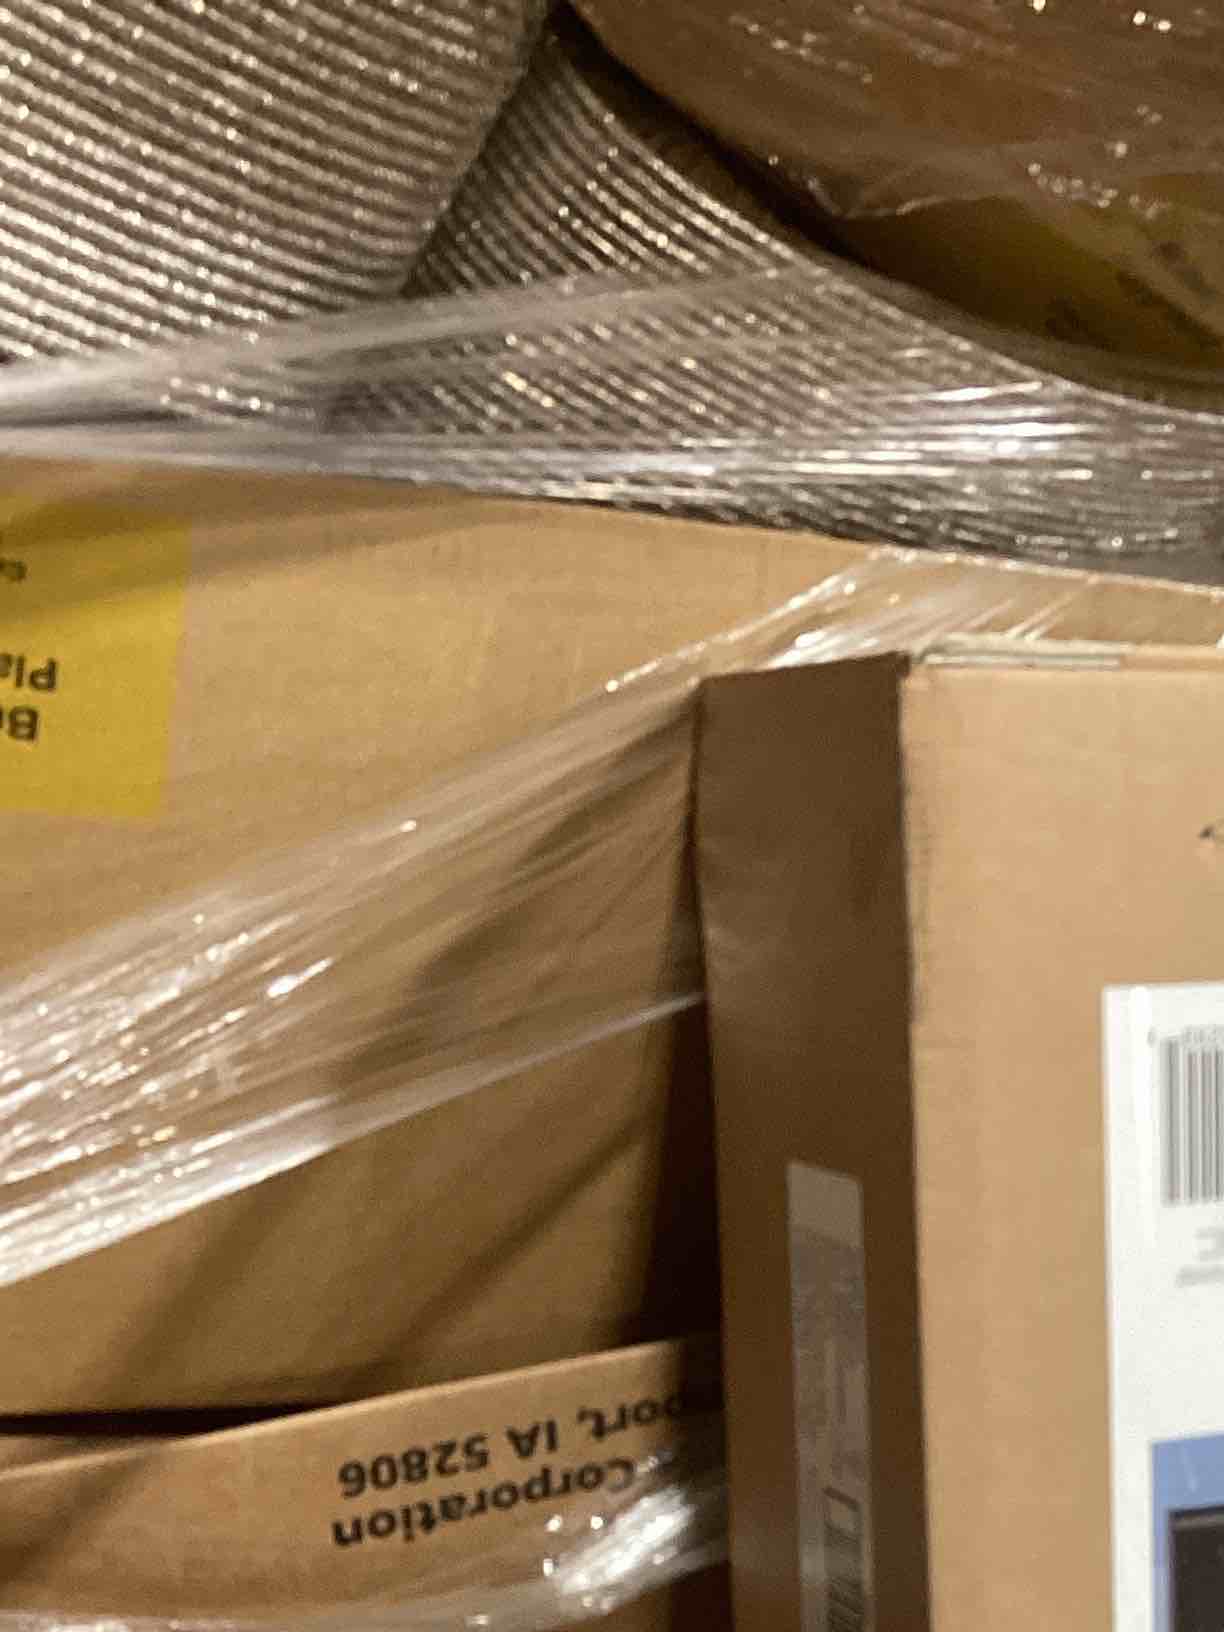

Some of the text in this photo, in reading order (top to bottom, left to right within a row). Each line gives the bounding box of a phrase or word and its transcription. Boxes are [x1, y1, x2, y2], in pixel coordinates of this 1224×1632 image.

[338, 1434, 490, 1499] 52806
[505, 1419, 559, 1461] IA
[332, 1459, 635, 1550] Corporation
